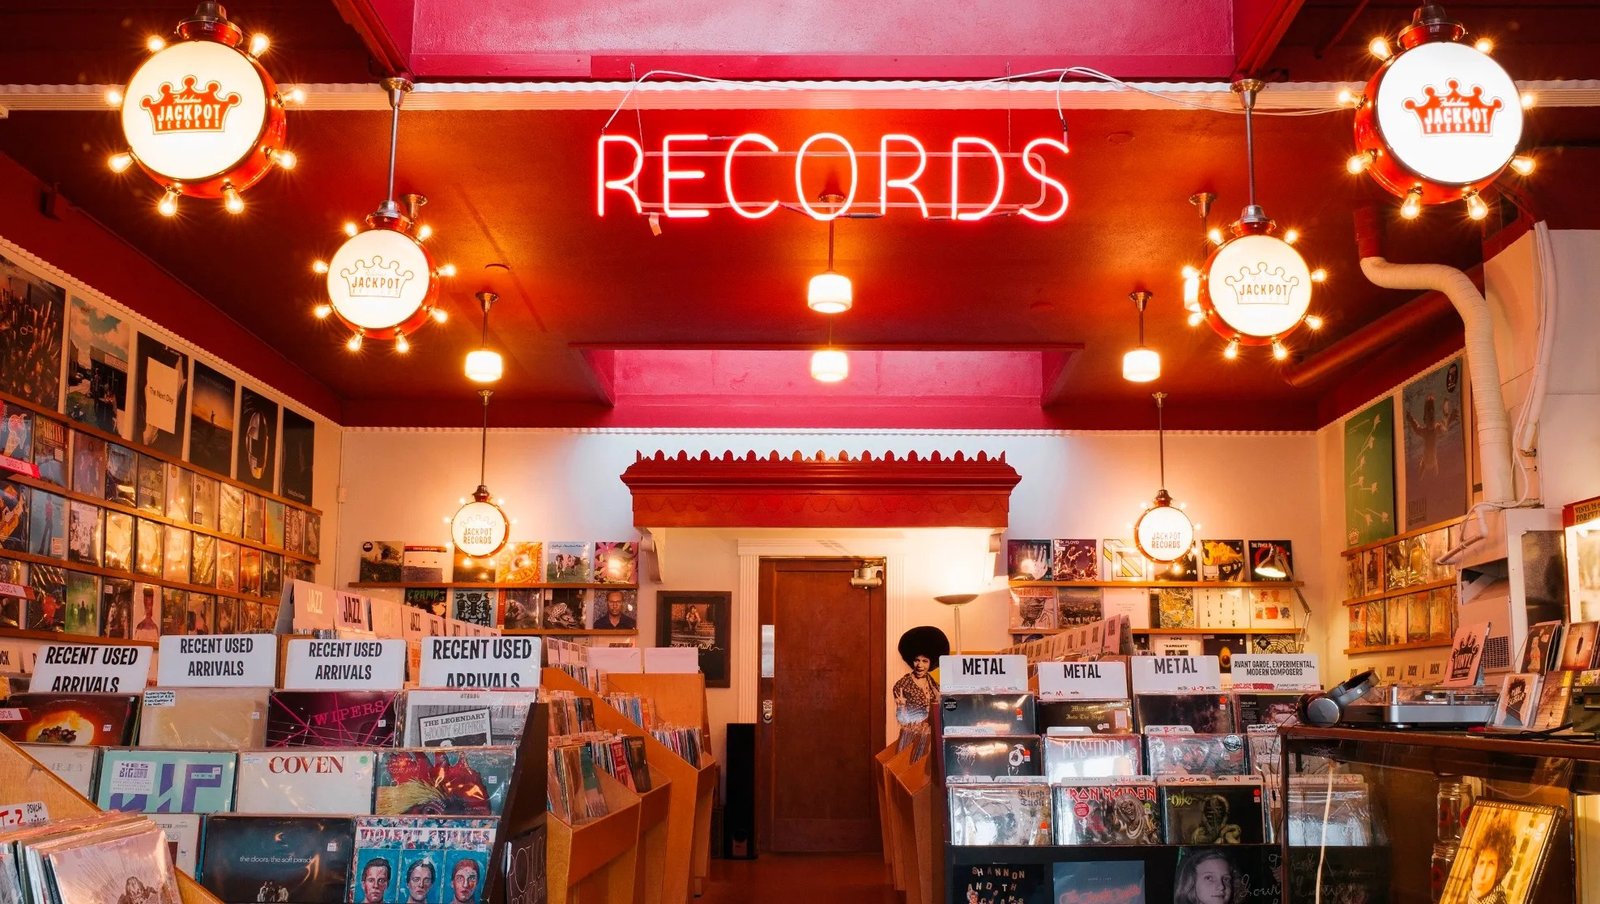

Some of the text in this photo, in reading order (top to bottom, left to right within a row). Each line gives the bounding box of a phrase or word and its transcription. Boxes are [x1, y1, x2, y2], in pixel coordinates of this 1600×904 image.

[157, 104, 221, 122] JACKPOT
[1424, 107, 1489, 124] JACKPOT
[158, 120, 220, 130] RECORDS
[597, 132, 1071, 221] RECORDS
[352, 277, 399, 289] JACKPOT
[1239, 284, 1287, 296] JACKPOT
[464, 527, 492, 536] JACKPOT
[1151, 532, 1181, 540] JACKPOT
[464, 536, 492, 544] RECORDS
[1151, 540, 1181, 549] RECORDS
[307, 589, 323, 614] JAZZ
[343, 596, 361, 624] JAZZ
[180, 637, 254, 654] RECENT USED
[308, 642, 383, 658] RECENT USED
[433, 639, 532, 660] RECENT USED
[45, 646, 138, 665] RECENT USED
[187, 660, 244, 676] ARRIVALS
[315, 665, 372, 680] ARRIVALS
[962, 658, 1006, 675] METAL
[1064, 664, 1101, 679] METAL
[1155, 658, 1198, 675] METAL
[1234, 660, 1315, 669] AVANT GARDE, EXPERIMENTAL,
[1246, 668, 1303, 676] MODERN COMPOSERS
[51, 675, 120, 693] ARRIVALS
[446, 672, 520, 688] ARRIVALS
[314, 700, 385, 726] WIPERS
[424, 712, 486, 728] THE LEGENDARY
[1062, 740, 1124, 758] MASTODON
[269, 755, 345, 774] COVEN
[1521, 806, 1552, 815] RECORDING
[360, 829, 491, 844] VIOLENT FEMMES
[972, 866, 1025, 880] SHANNON
